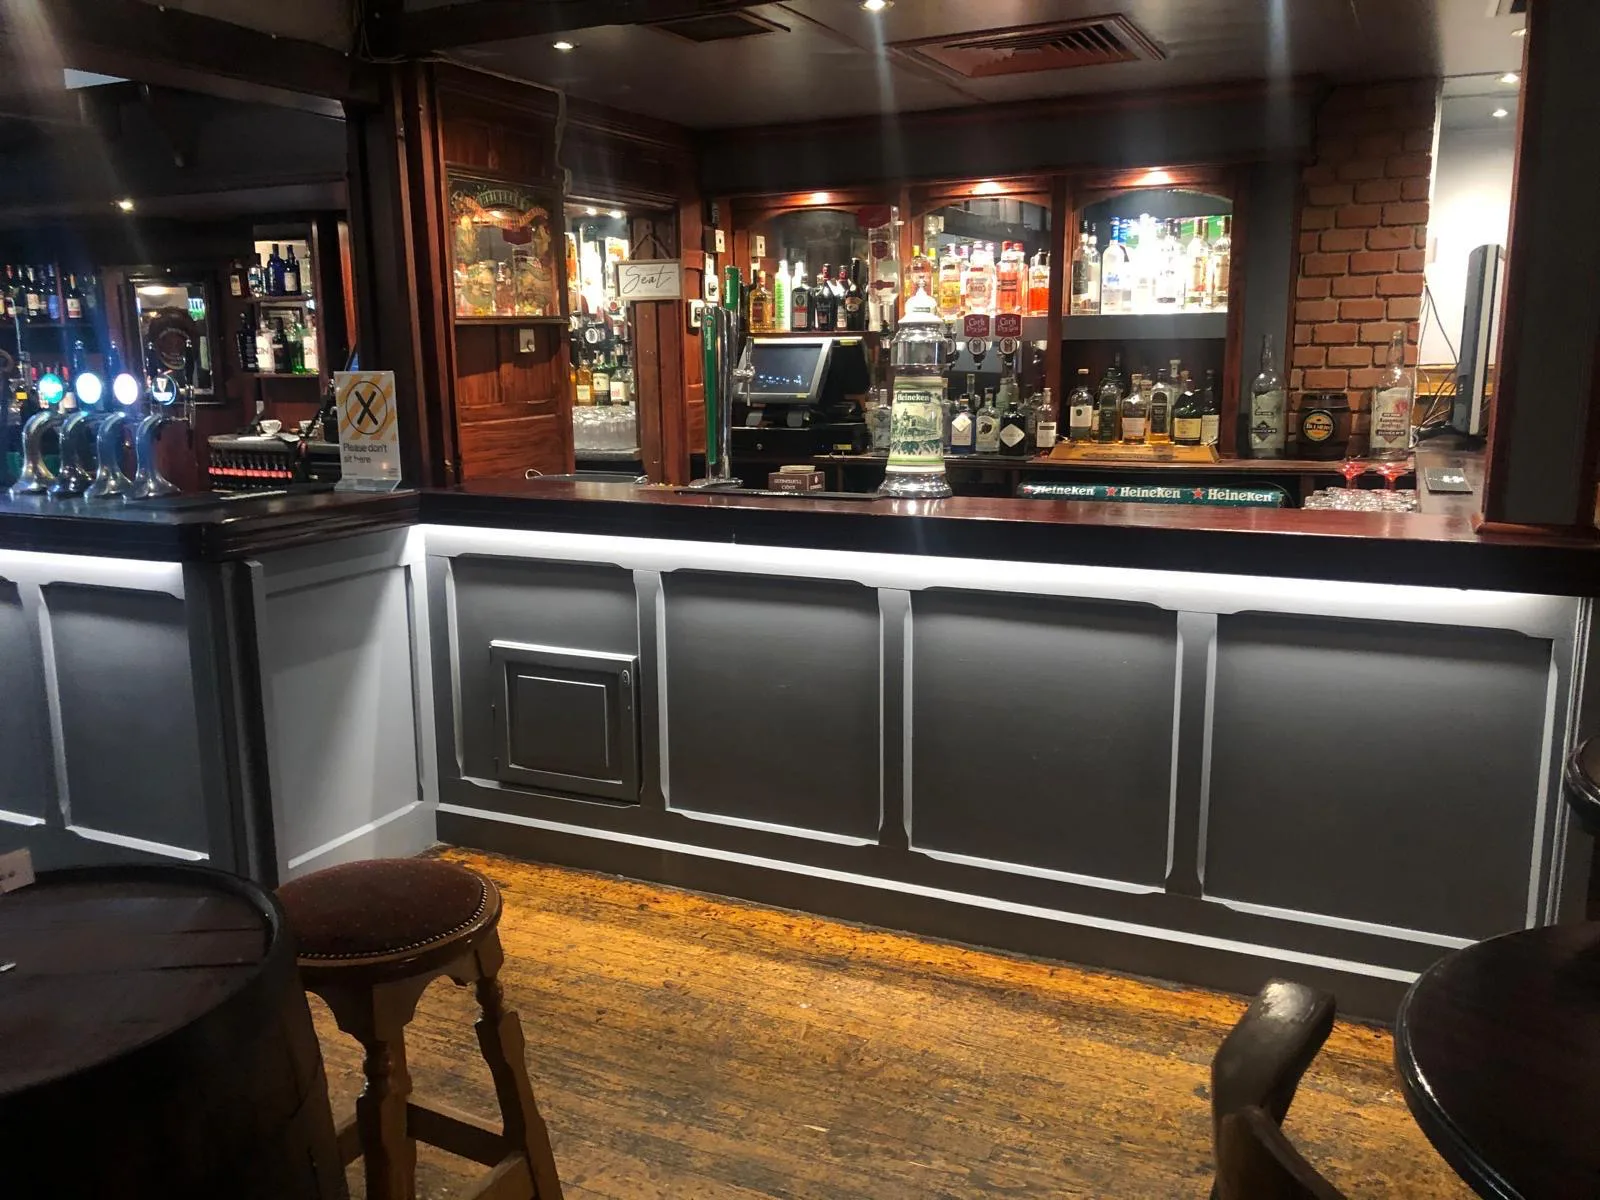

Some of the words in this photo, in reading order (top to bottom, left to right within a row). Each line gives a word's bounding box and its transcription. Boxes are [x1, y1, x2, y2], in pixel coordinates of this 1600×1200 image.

[623, 265, 675, 294] Seat
[897, 394, 930, 402] Heineken
[343, 443, 367, 452] Please
[1033, 485, 1095, 496] Heineken
[1120, 486, 1181, 499] Heineken
[1207, 488, 1273, 502] Heineken
